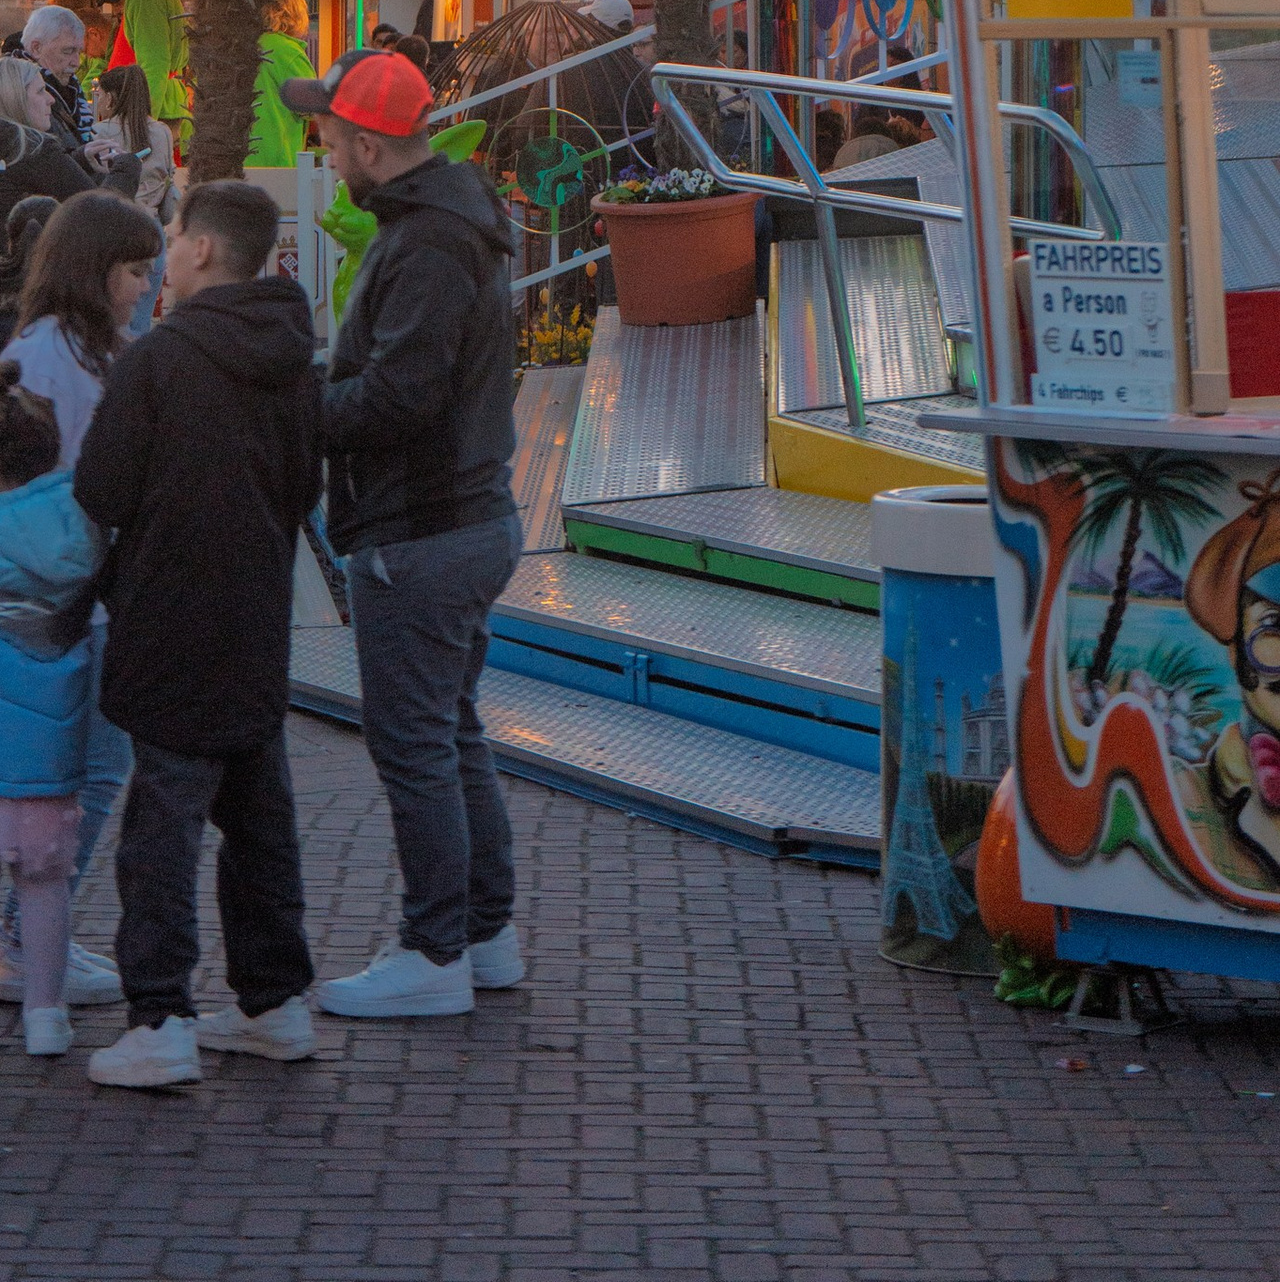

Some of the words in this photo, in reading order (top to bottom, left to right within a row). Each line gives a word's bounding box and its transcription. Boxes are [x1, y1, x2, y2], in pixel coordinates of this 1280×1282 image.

[1034, 244, 1162, 274] FAHRPREIS
[1043, 292, 1053, 312] a
[1062, 286, 1127, 315] Person
[1043, 327, 1061, 353] €
[1071, 329, 1124, 357] 4.50
